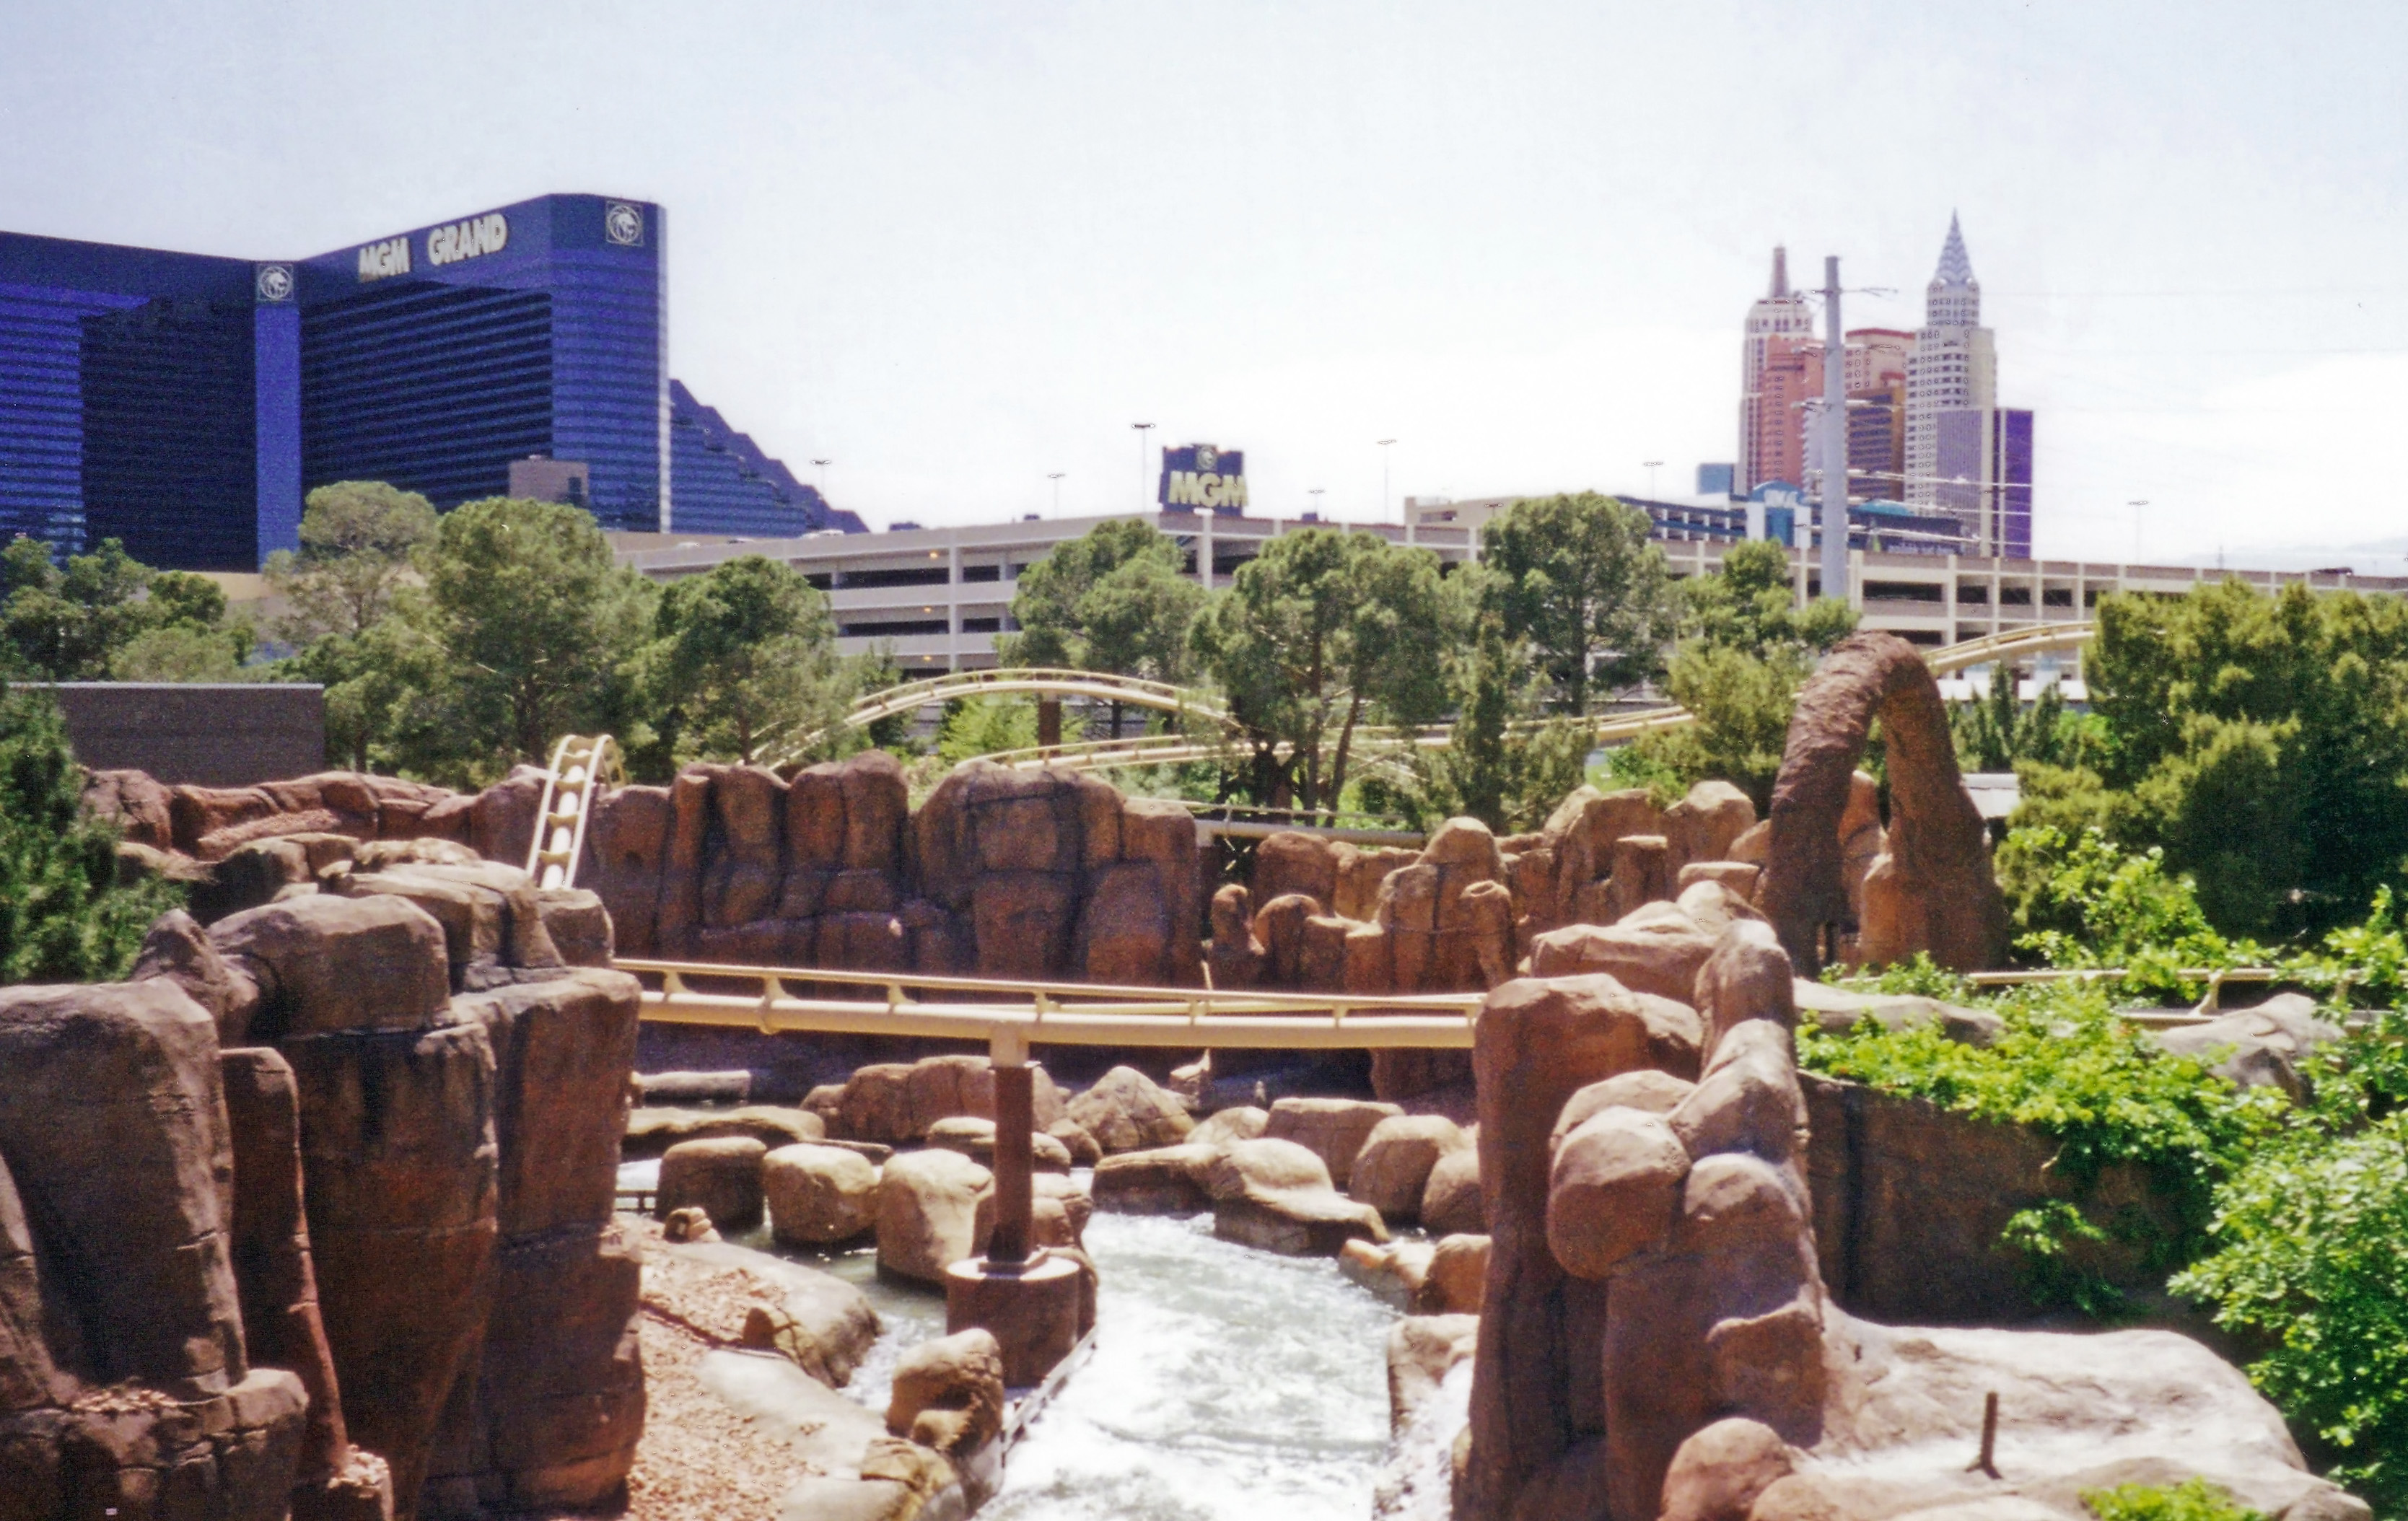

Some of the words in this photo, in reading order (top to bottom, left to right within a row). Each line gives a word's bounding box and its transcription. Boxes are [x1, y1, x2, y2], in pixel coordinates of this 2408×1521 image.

[359, 237, 410, 282] MGM
[427, 214, 507, 266] GRAND
[1168, 471, 1248, 507] MGM
